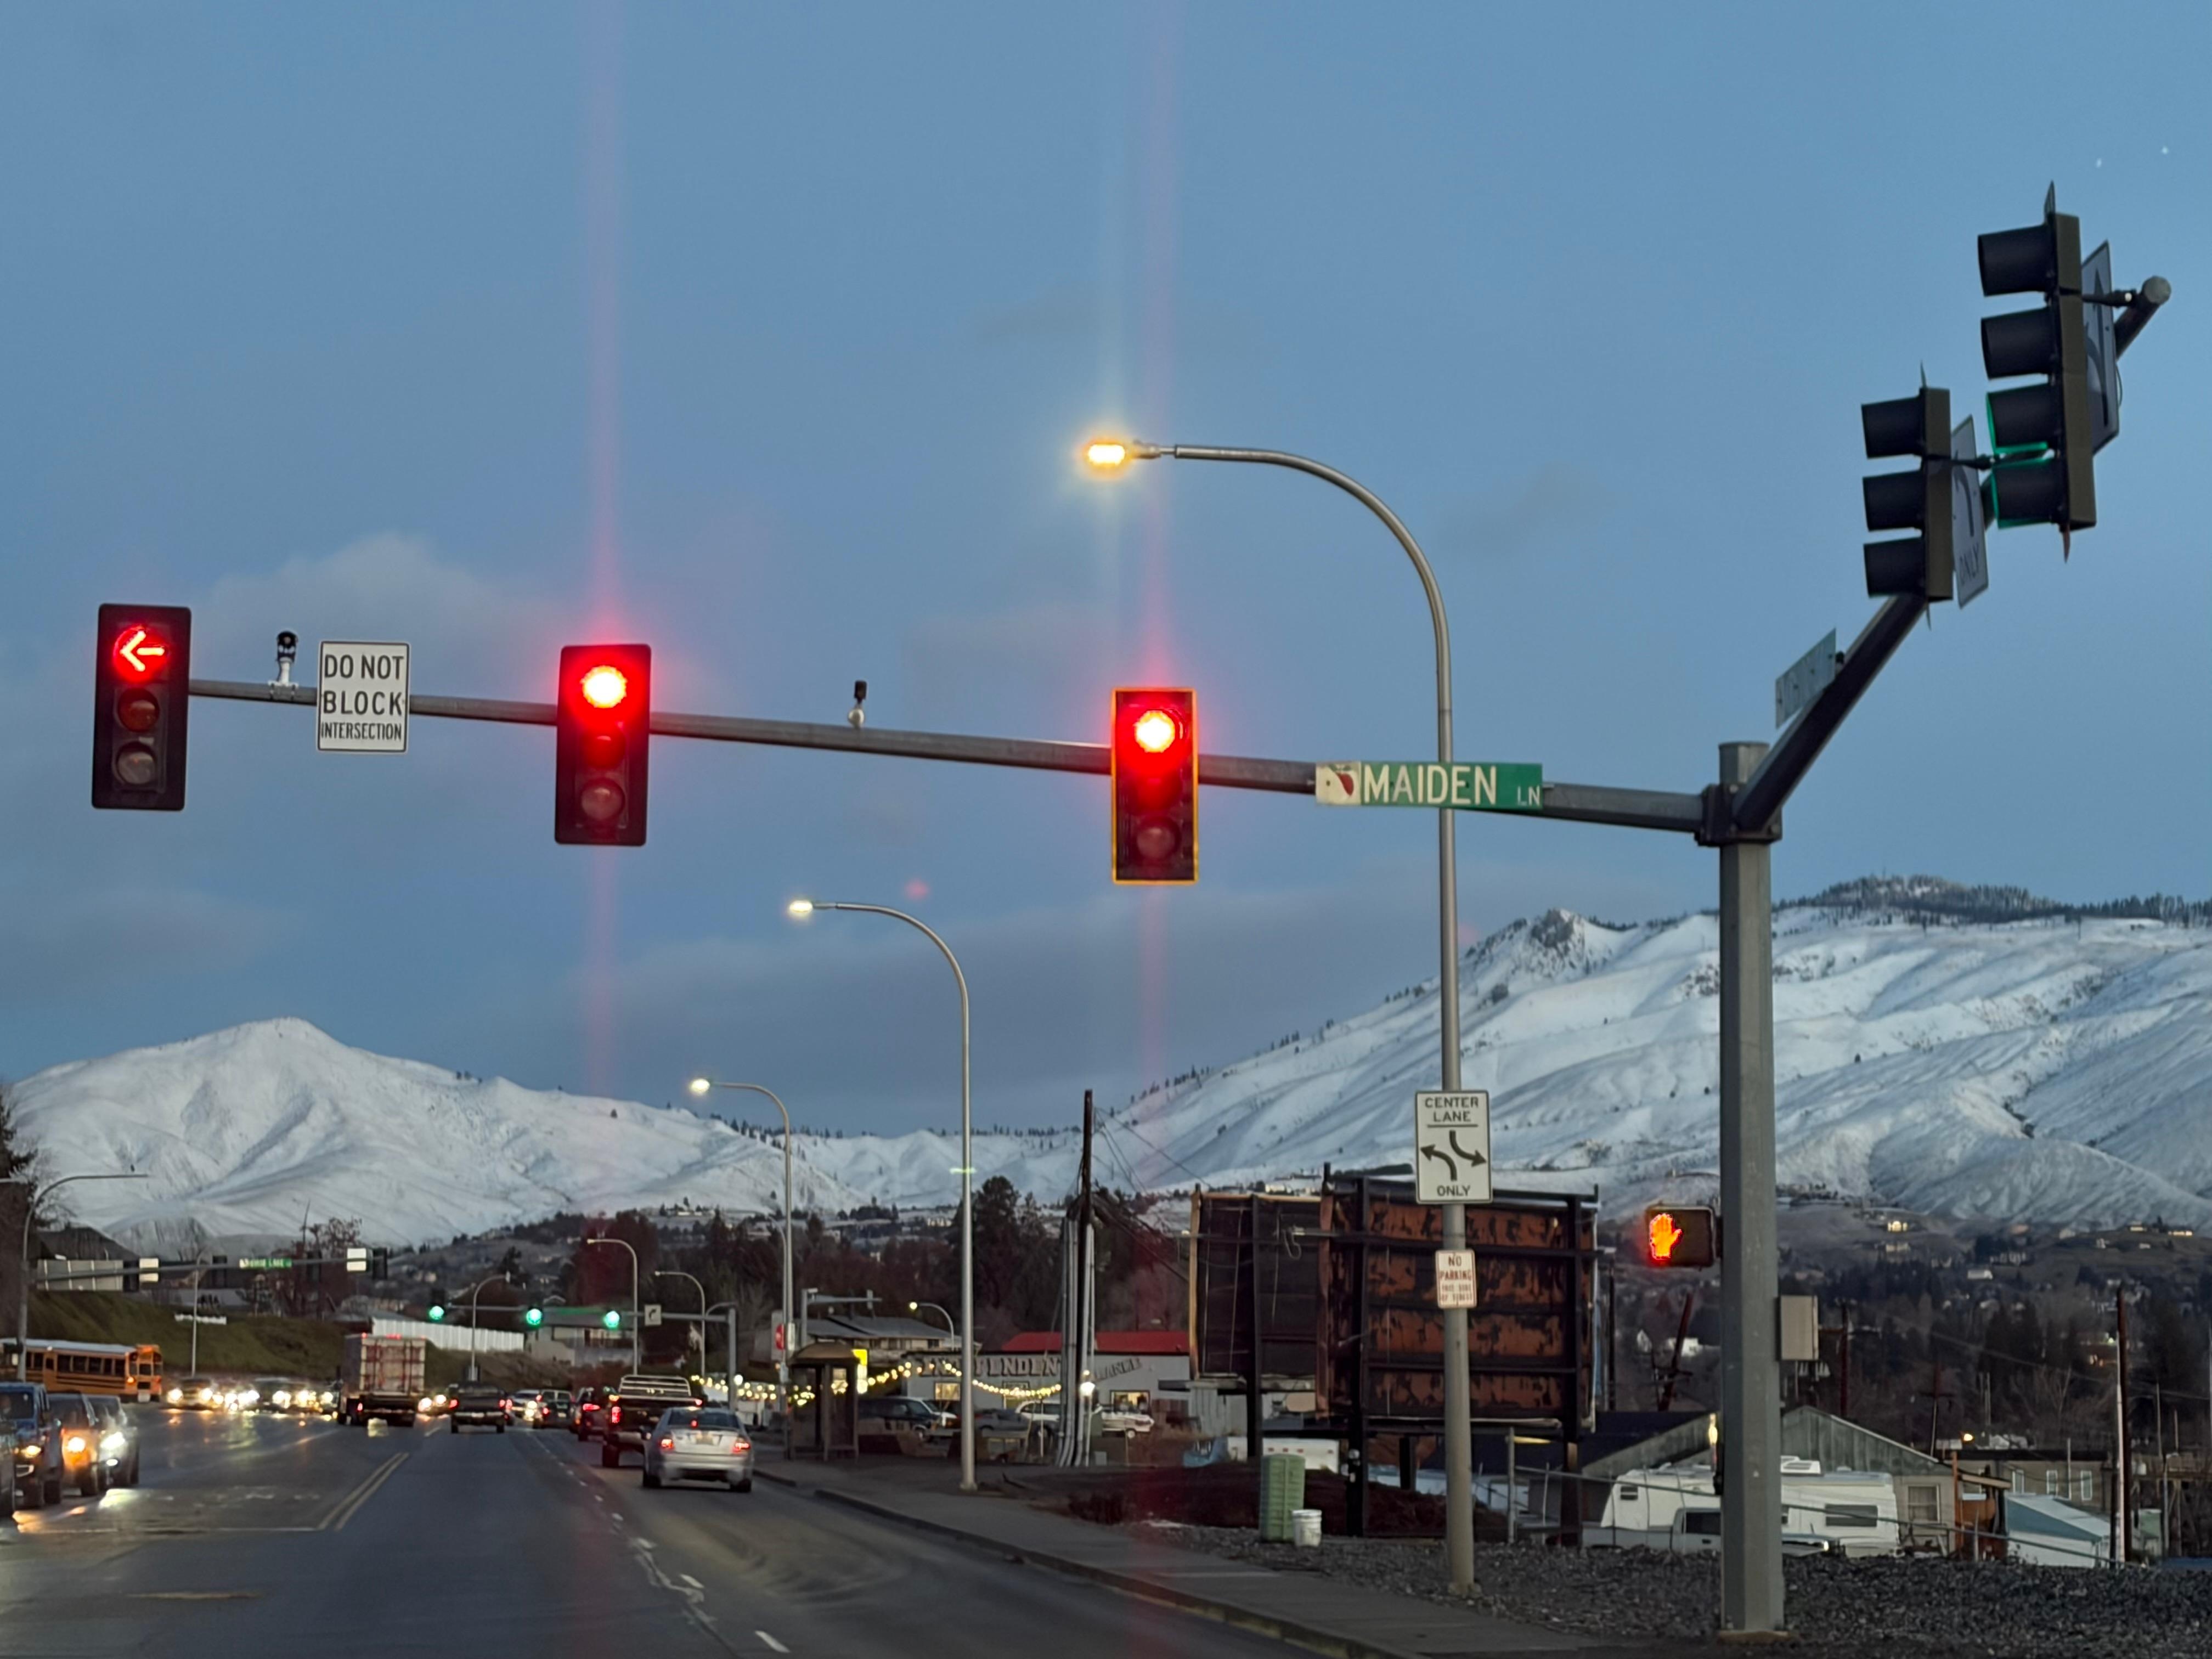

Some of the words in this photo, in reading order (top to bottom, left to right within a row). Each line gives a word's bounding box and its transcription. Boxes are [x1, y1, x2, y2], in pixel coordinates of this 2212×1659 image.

[325, 654, 353, 678] DO
[361, 654, 404, 680] NOT
[323, 690, 402, 715] BLOCK
[321, 721, 402, 740] INTERSECTION
[1364, 764, 1496, 804] MAIDEN
[1517, 785, 1539, 806] LN
[1425, 1097, 1479, 1108] CENTER
[1434, 1111, 1471, 1122] LANE
[1437, 1185, 1470, 1197] ONLY
[1448, 1256, 1462, 1267] NO
